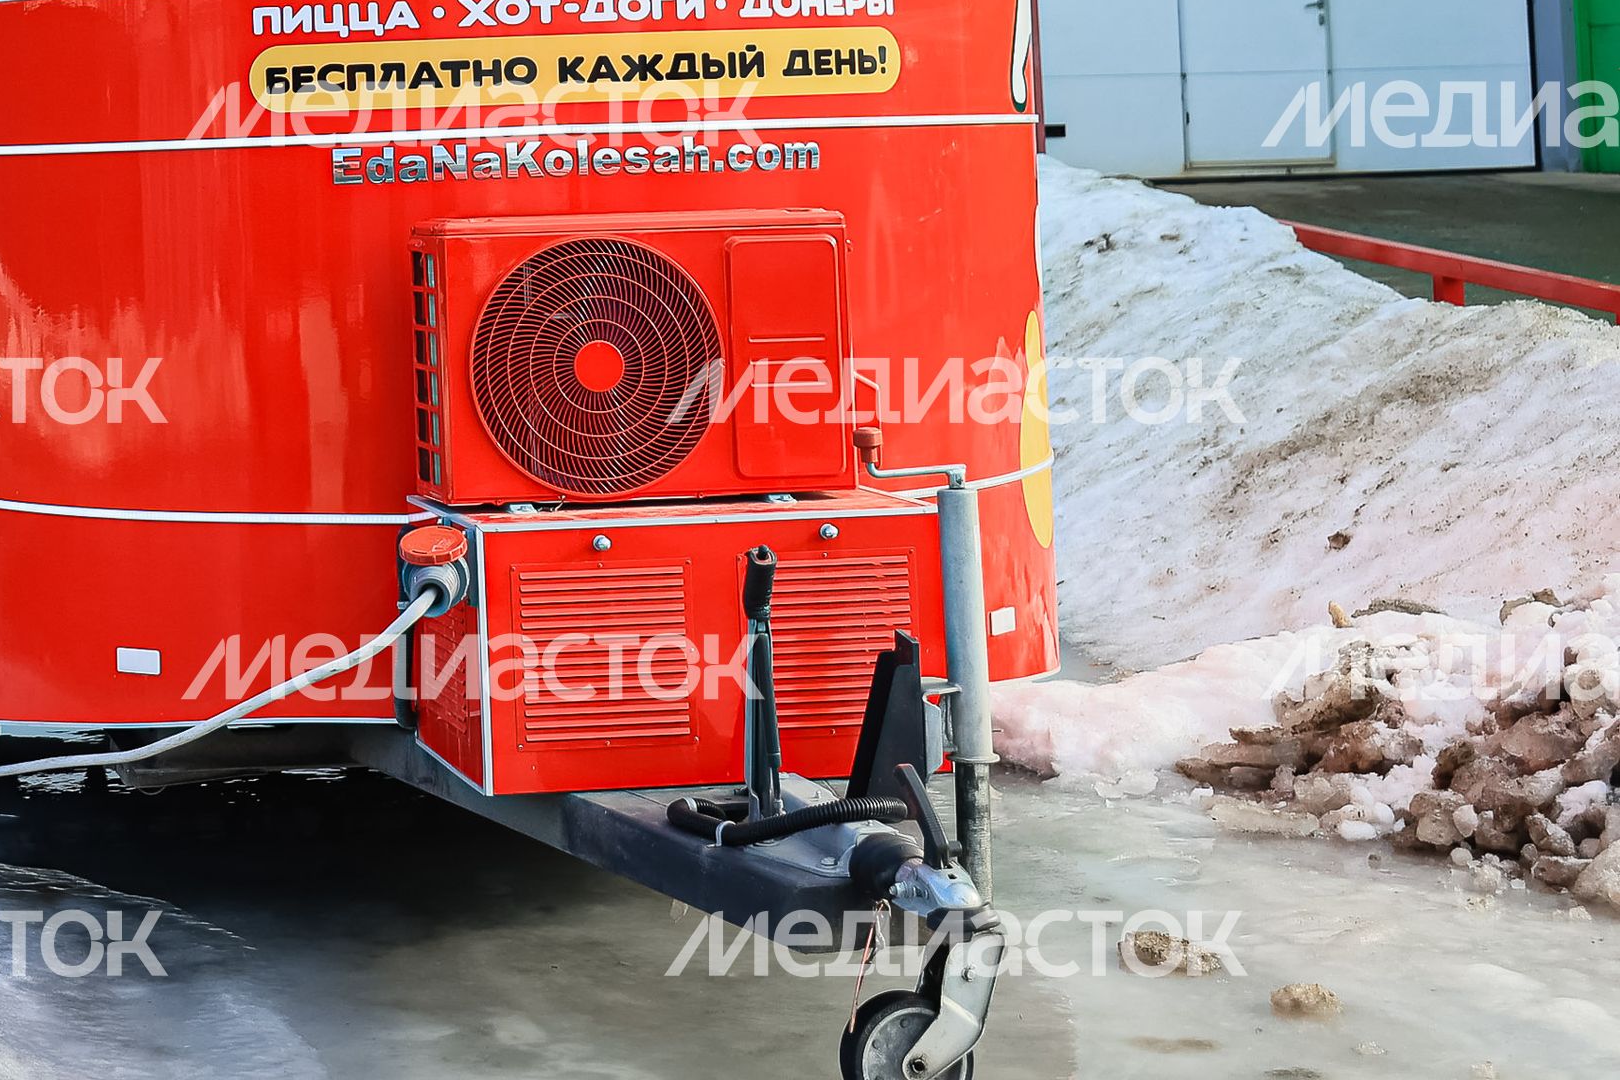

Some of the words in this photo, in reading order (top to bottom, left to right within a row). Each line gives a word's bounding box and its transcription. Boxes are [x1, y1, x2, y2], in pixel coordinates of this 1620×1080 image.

[253, 0, 420, 38] ПИЦЦА
[264, 53, 539, 95] БЕСПЛАТНО
[558, 45, 766, 85] КАЖДЫЙ
[782, 44, 886, 78] ДЕНЬ!
[332, 139, 820, 185] EdaNaKolesah.com
